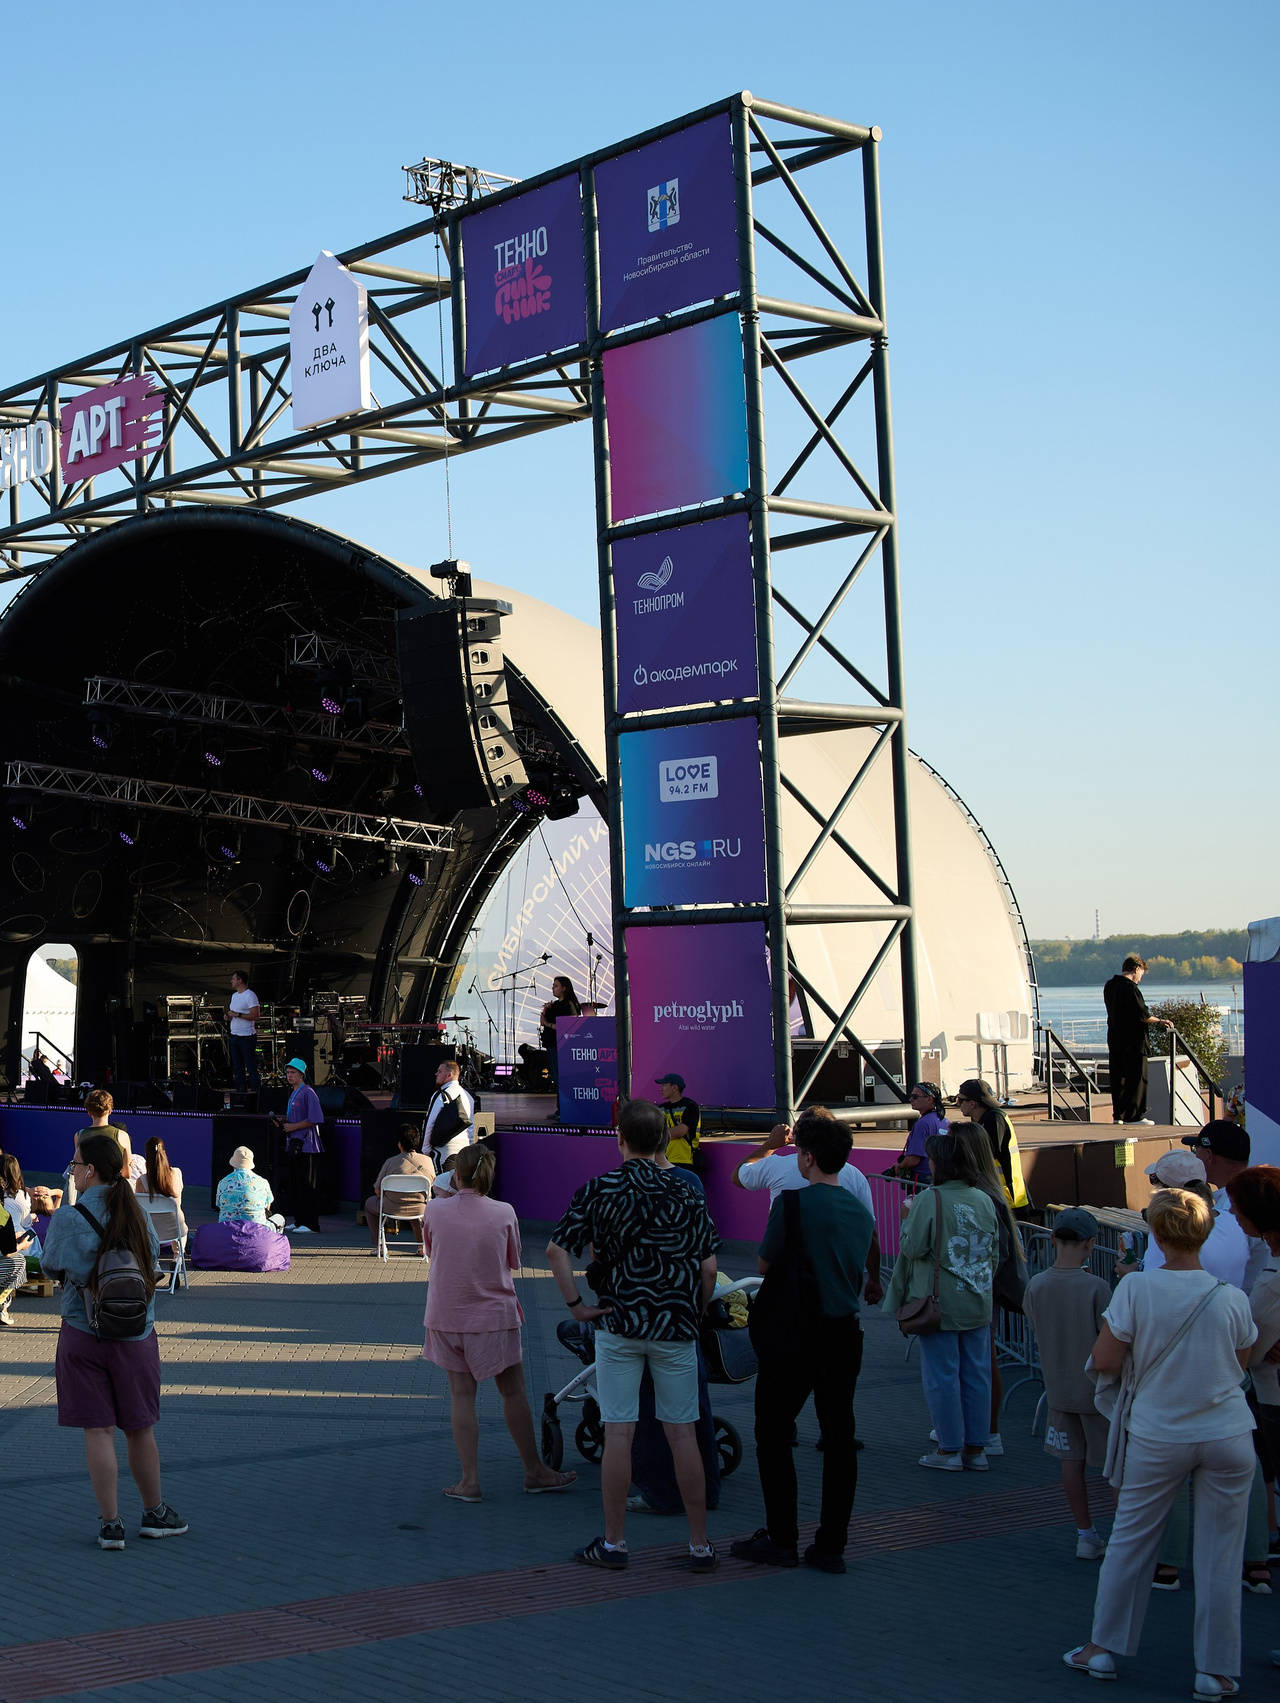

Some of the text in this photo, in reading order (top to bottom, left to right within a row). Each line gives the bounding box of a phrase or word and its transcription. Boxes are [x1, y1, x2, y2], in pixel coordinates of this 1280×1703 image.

[494, 226, 548, 272] ТЕХНО
[637, 242, 693, 267] Правительство
[623, 247, 710, 282] Новосибирской области
[313, 342, 337, 361] ДВА
[304, 355, 347, 378] КЛЮЧА
[67, 396, 126, 464] АРТ
[633, 592, 685, 615] ТЕХНОПРОМ
[650, 659, 738, 684] академпарк
[669, 783, 709, 795] 94.2 FM
[645, 840, 697, 862] NGS
[644, 860, 711, 870] НОВОСИБИРСК ОНЛАЙН
[487, 833, 590, 991] СИБИРСКИЙ
[653, 1000, 744, 1023] petroglyph
[571, 1048, 598, 1061] ТЕХНО
[573, 1087, 599, 1100] ТЕХНО
